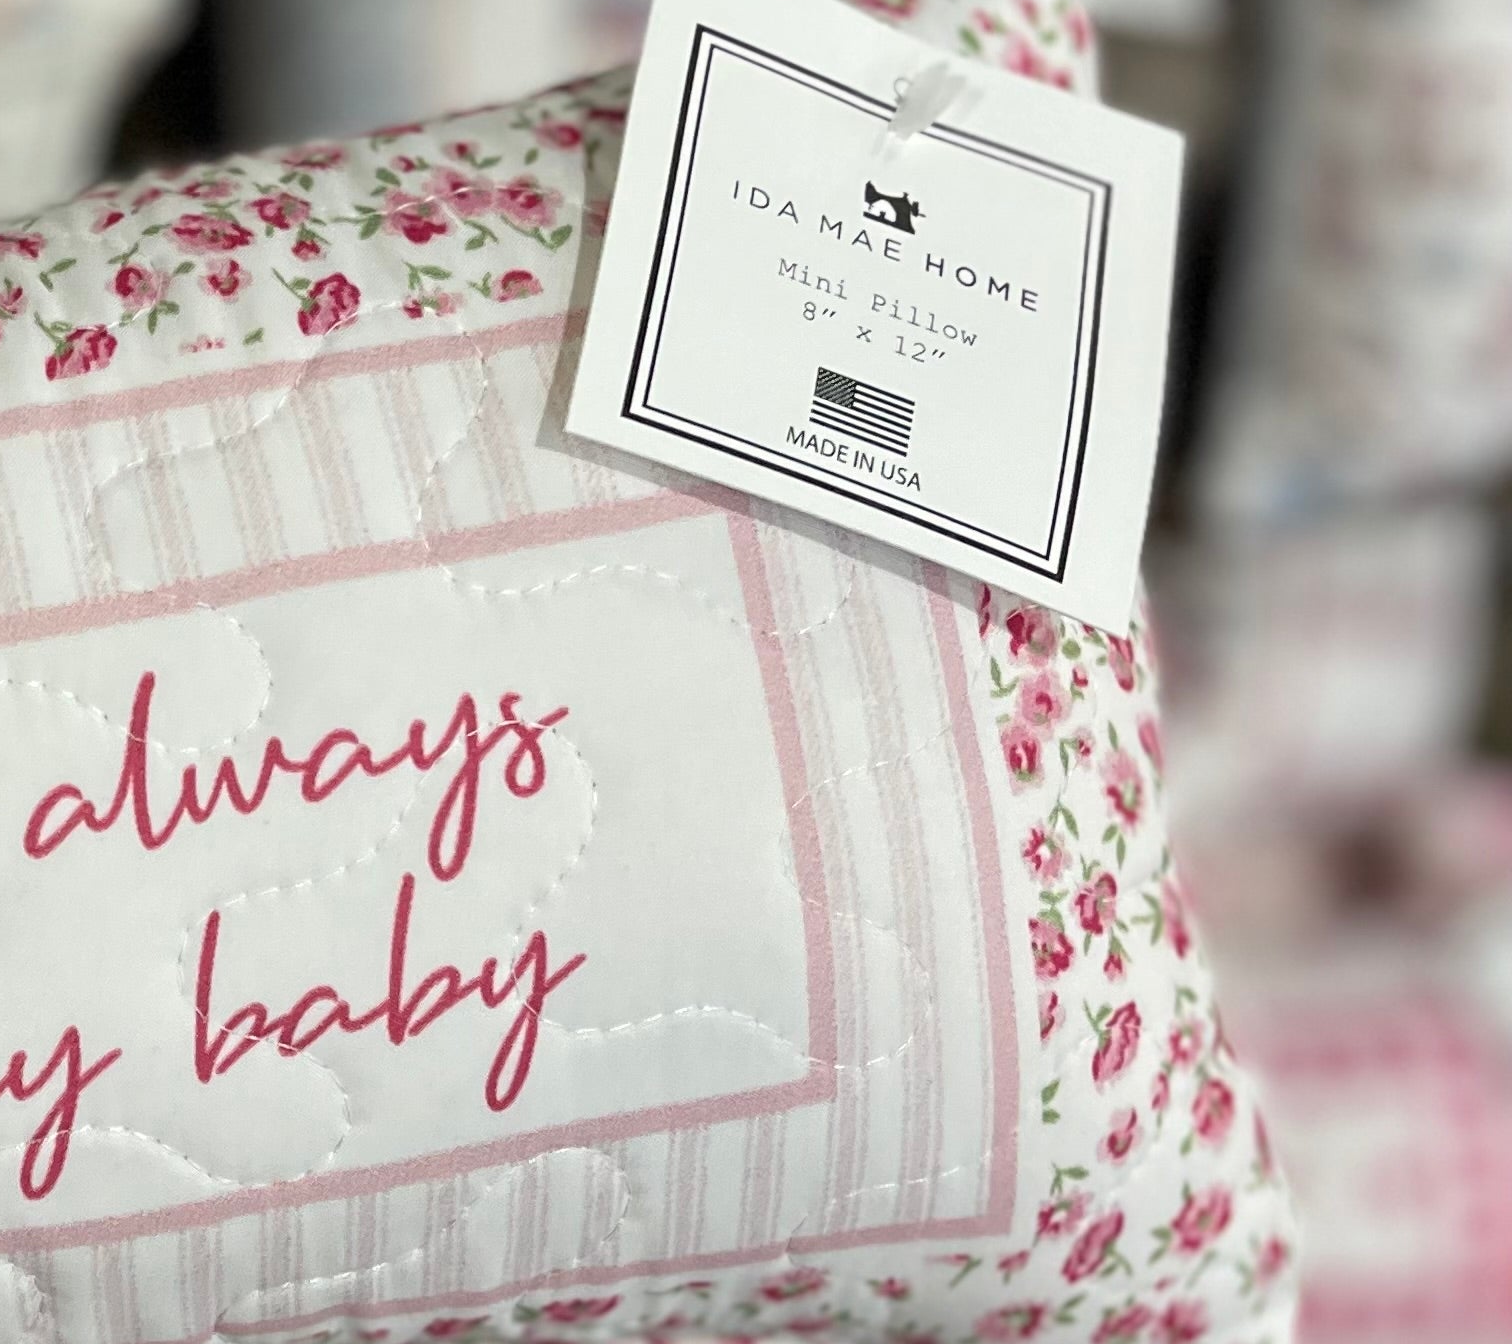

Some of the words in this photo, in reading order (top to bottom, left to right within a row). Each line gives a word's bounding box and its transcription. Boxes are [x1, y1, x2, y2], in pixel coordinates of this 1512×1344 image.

[733, 179, 799, 224] IDA
[819, 214, 902, 262] MAE
[925, 253, 1039, 313] HOME
[777, 257, 848, 301] Mini
[870, 293, 978, 347] Pillow
[855, 325, 873, 343] x
[786, 426, 850, 465] MADE
[852, 450, 876, 474] IN
[880, 460, 921, 492] USA
[23, 670, 570, 880] always
[193, 873, 588, 1112] baby
